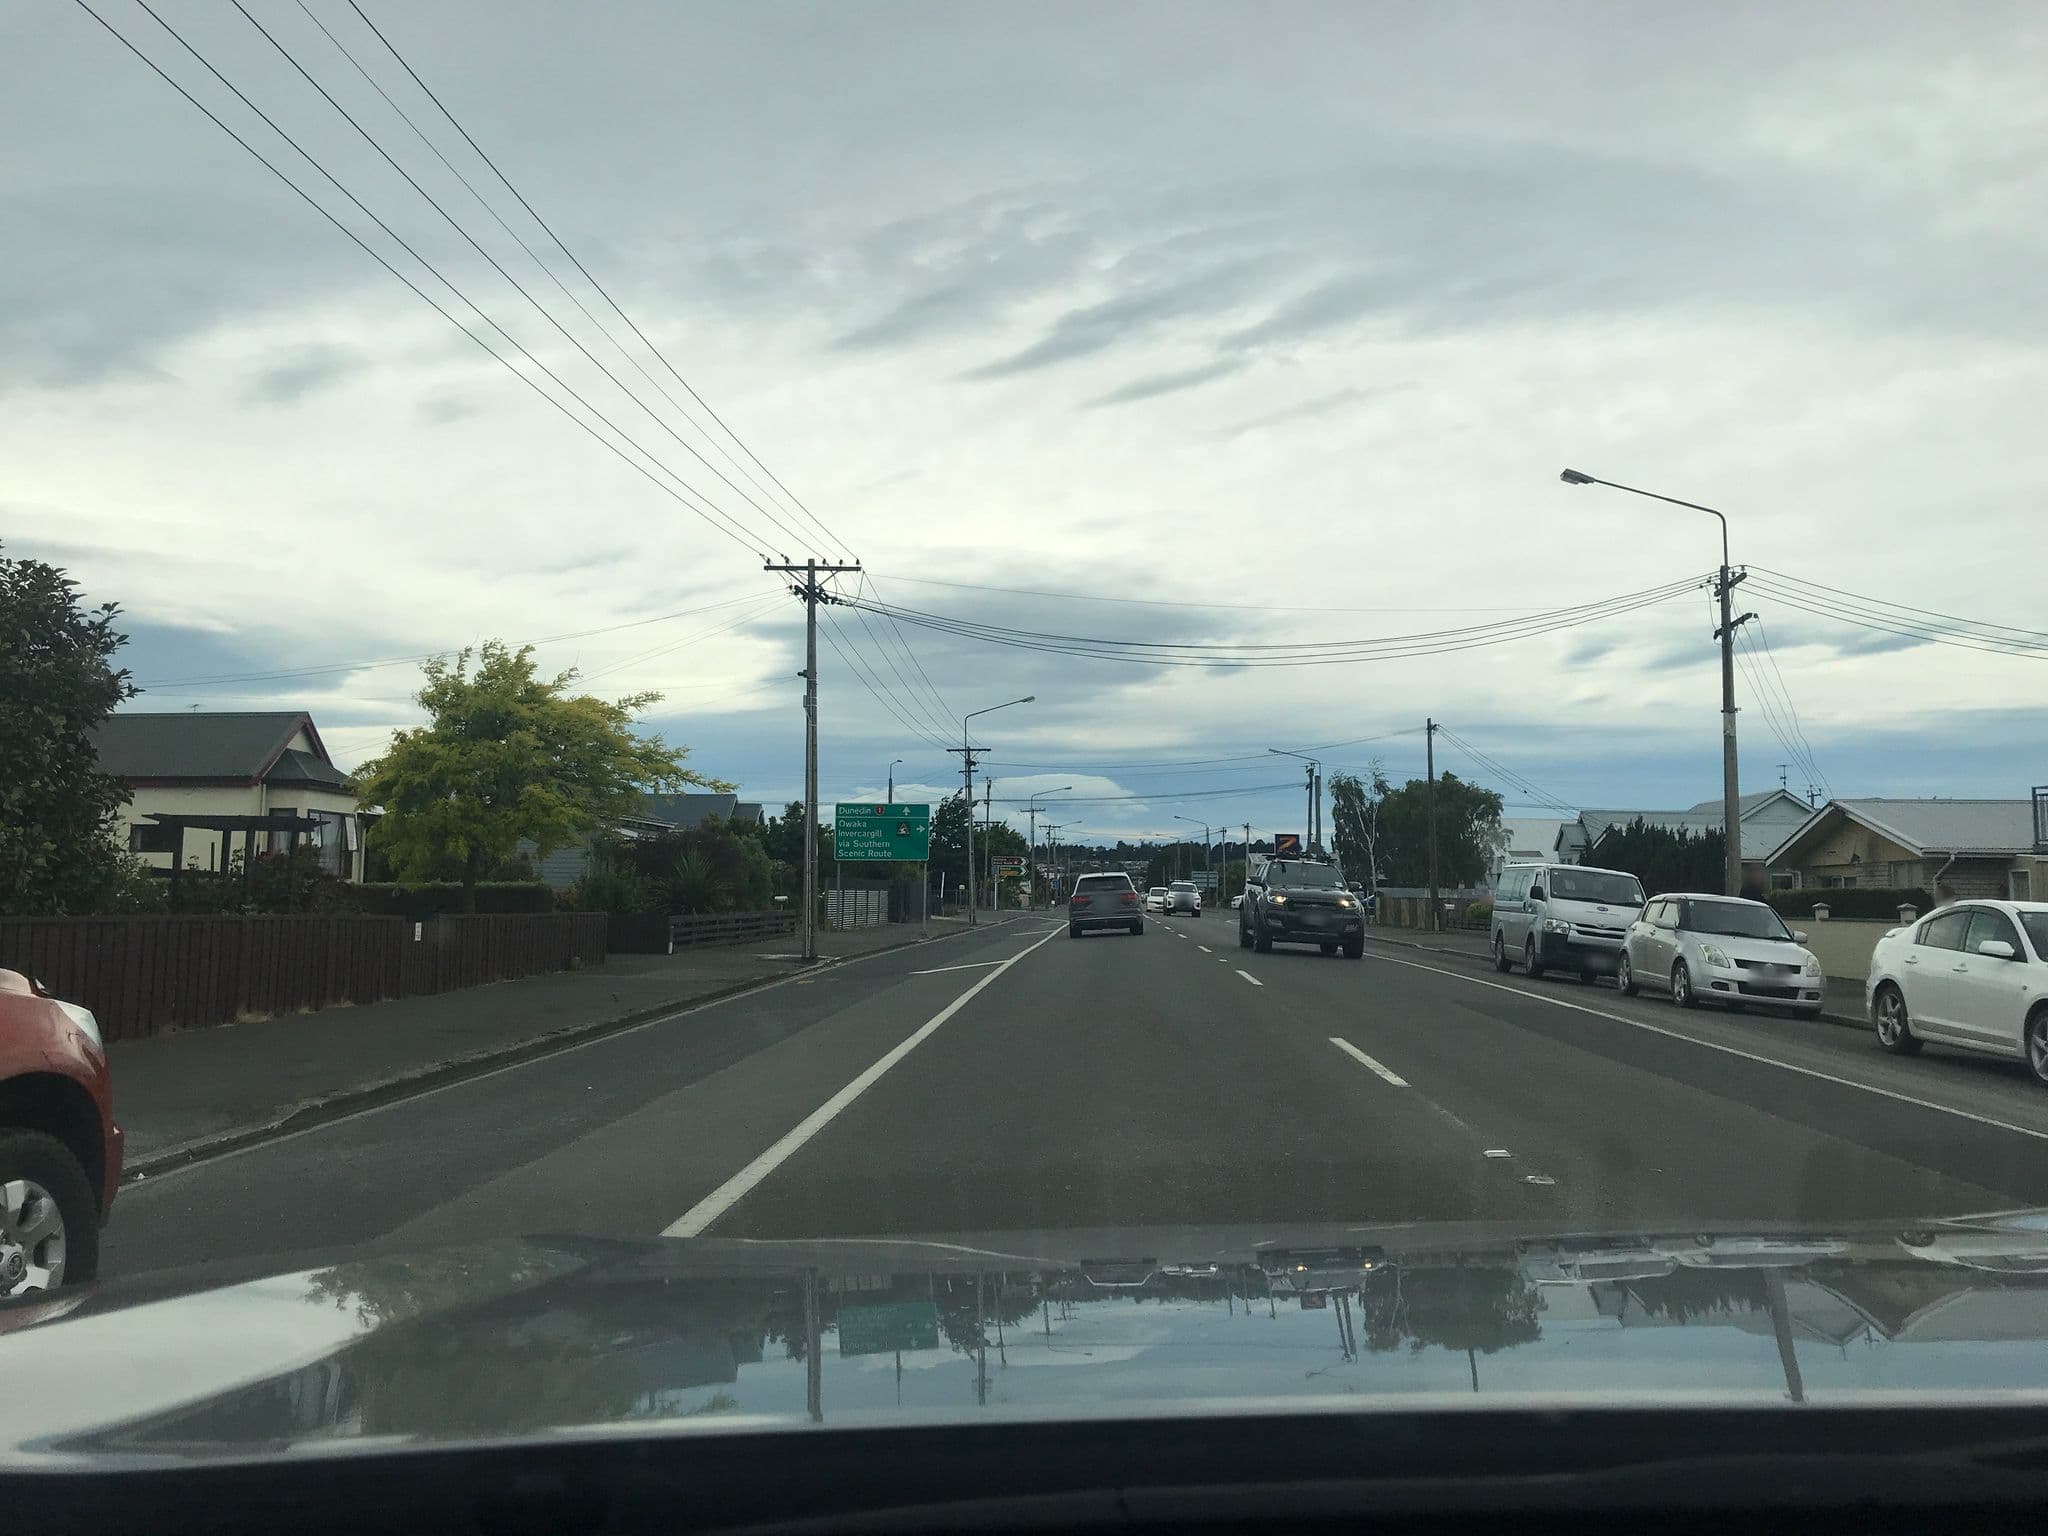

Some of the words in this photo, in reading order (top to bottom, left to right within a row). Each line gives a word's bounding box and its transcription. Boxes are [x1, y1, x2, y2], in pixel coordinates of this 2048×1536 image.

[838, 806, 872, 815] Dunedin
[838, 820, 867, 828] Owaka
[838, 830, 882, 838] Invercargill
[853, 840, 890, 848] Southern
[838, 849, 865, 857] Scenic
[868, 849, 893, 858] Route
